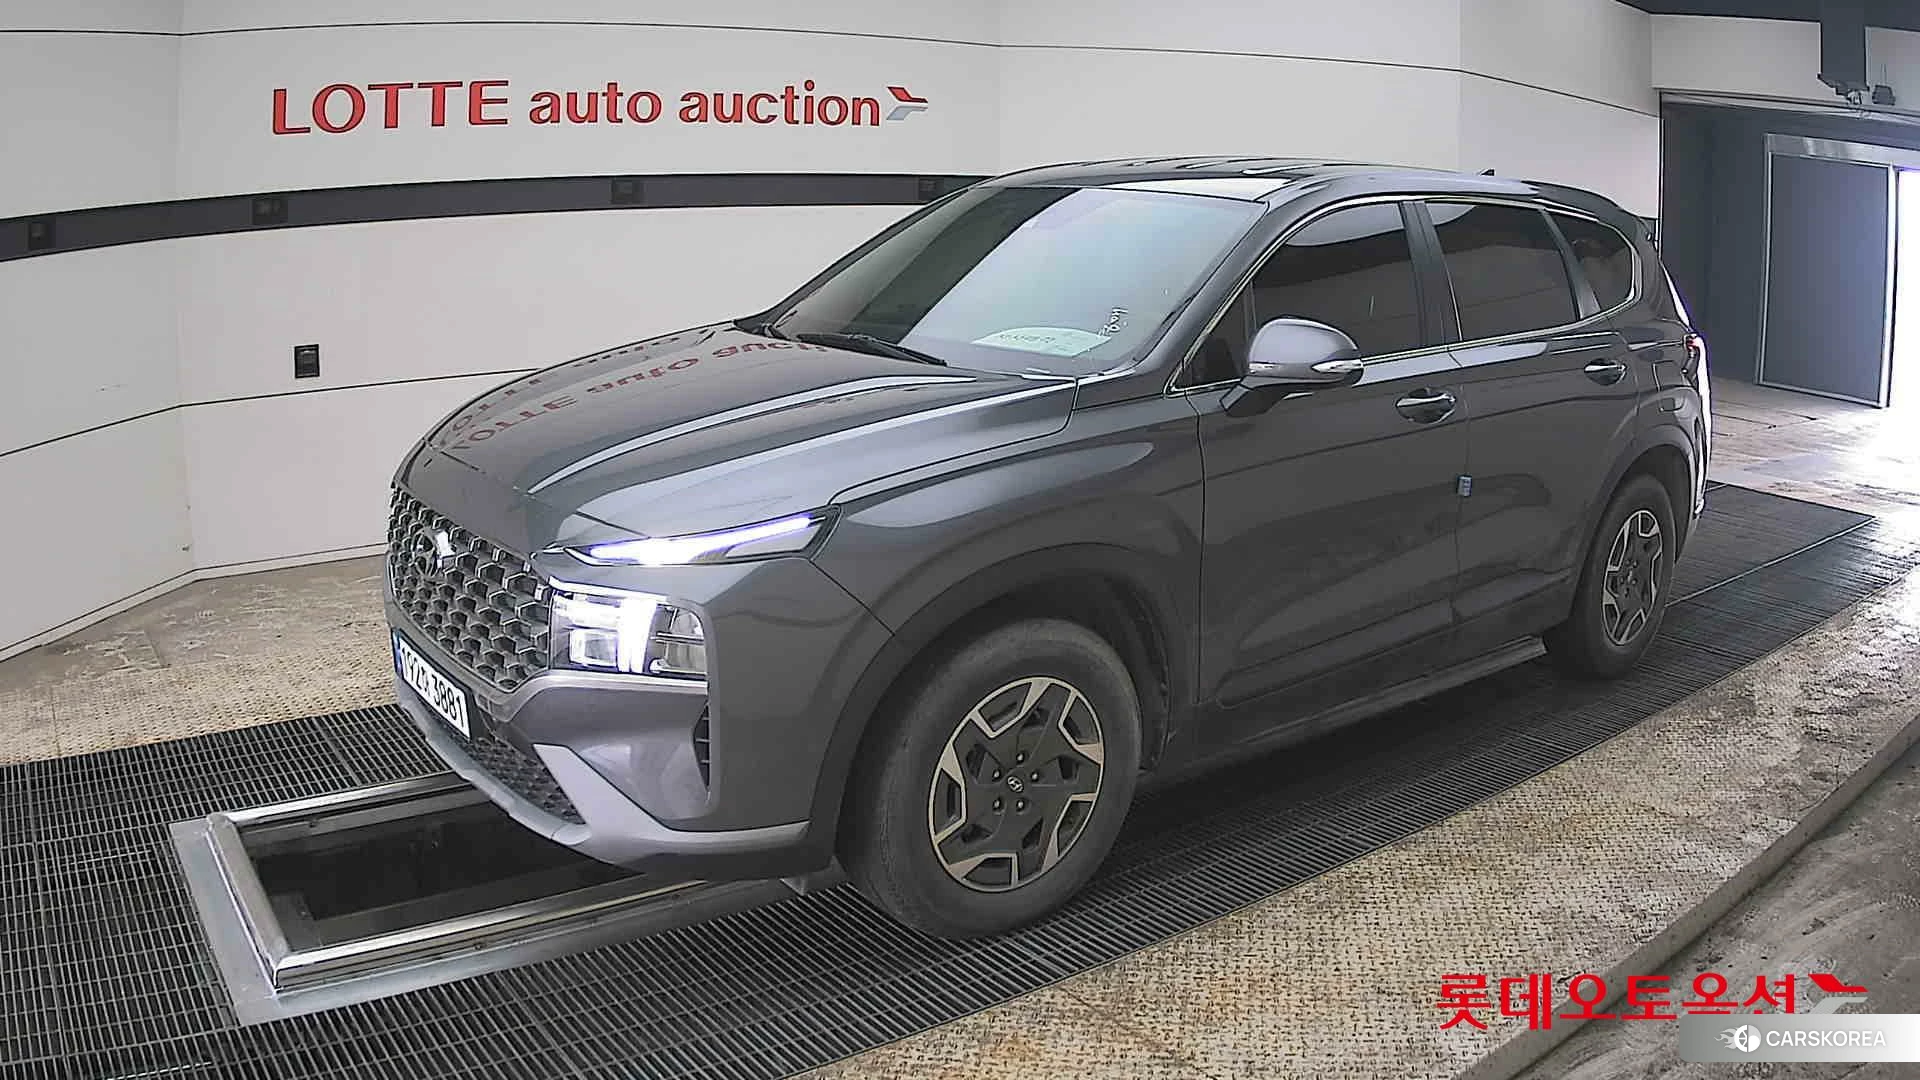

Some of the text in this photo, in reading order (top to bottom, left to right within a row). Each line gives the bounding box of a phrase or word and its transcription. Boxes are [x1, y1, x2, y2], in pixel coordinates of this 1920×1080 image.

[272, 80, 880, 135] LOTTE auto auction
